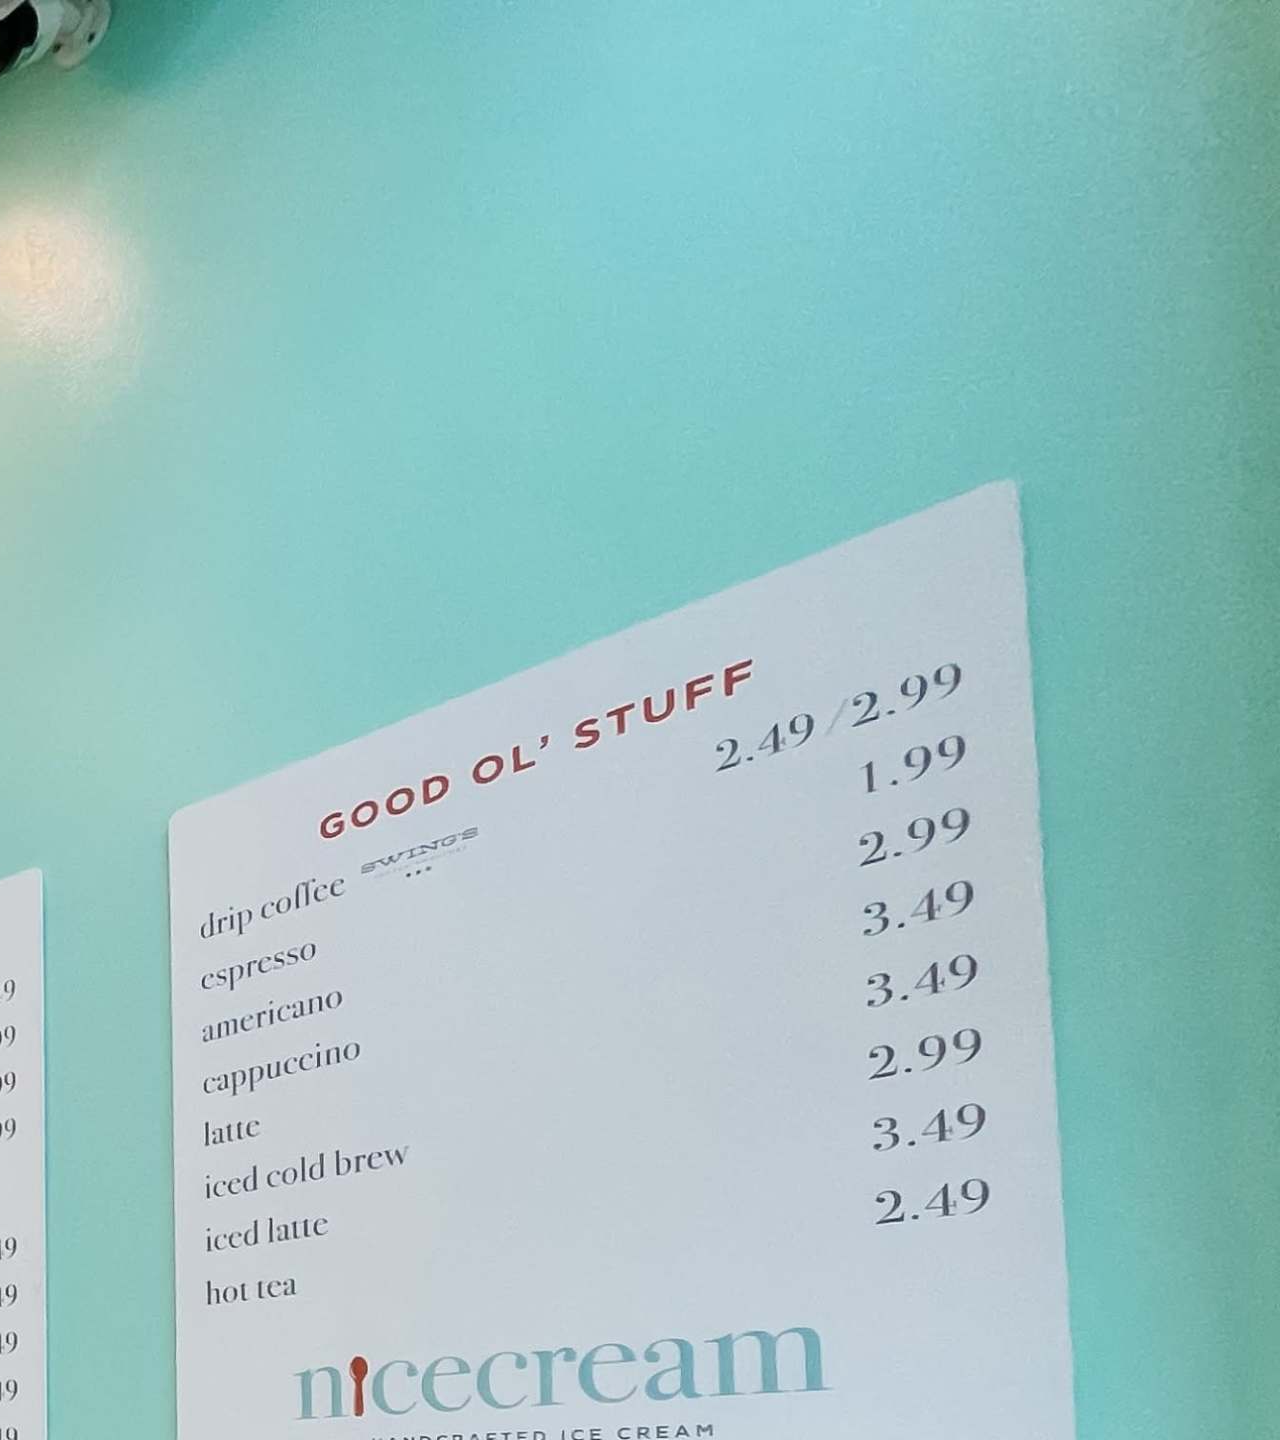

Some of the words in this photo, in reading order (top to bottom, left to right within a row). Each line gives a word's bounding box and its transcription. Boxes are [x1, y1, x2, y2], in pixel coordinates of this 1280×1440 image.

[715, 713, 815, 772] 2.49
[851, 662, 962, 727] 2.99
[318, 773, 450, 840] GOOD
[574, 659, 755, 750] STUFF
[860, 735, 967, 793] 1.99
[858, 807, 971, 866] 2.99
[200, 904, 253, 942] drip
[259, 872, 346, 926] coffee
[863, 880, 975, 937] 3.49
[200, 938, 317, 992] espresso
[866, 953, 979, 1009] 3.49
[201, 987, 343, 1044] americano
[202, 1035, 362, 1098] cappuccino
[867, 1027, 983, 1081] 2.99
[203, 1115, 261, 1147] latte
[872, 1102, 988, 1153] 3.49
[204, 1167, 259, 1201] iced
[266, 1154, 326, 1190] cold
[334, 1141, 410, 1177] brew
[874, 1177, 992, 1226] 2.49
[205, 1220, 259, 1253] iced
[267, 1213, 329, 1245] latte
[205, 1277, 250, 1308] hot
[256, 1274, 297, 1300] tea
[293, 1323, 834, 1421] nicecream
